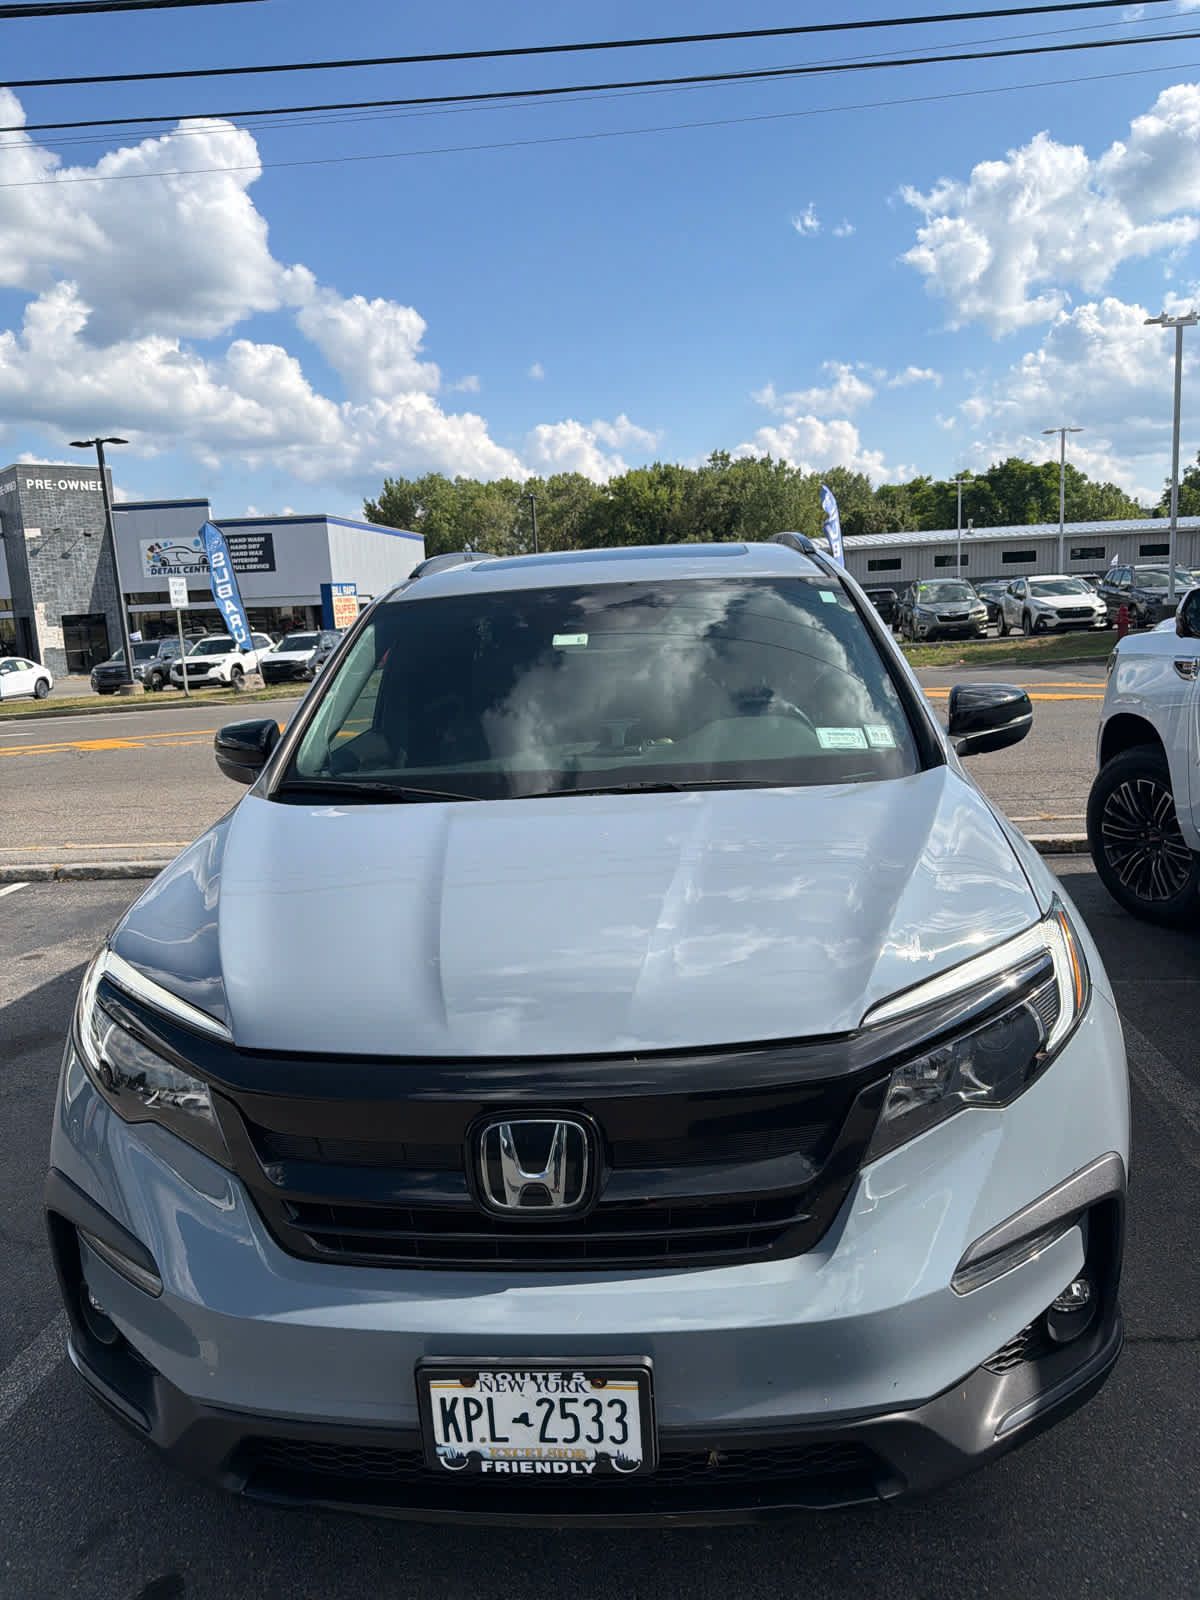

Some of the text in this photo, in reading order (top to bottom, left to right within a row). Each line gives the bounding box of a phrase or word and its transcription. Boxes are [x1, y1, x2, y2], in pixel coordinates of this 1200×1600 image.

[151, 565, 211, 575] DETAIL CENTE
[335, 603, 356, 615] SUPER
[478, 1372, 586, 1382] ROUTE 5
[478, 1380, 590, 1394] NEW YORK
[535, 1397, 629, 1445] 2533
[489, 1447, 590, 1460] EXCELSIOR
[481, 1461, 597, 1474] FRIENDLY
